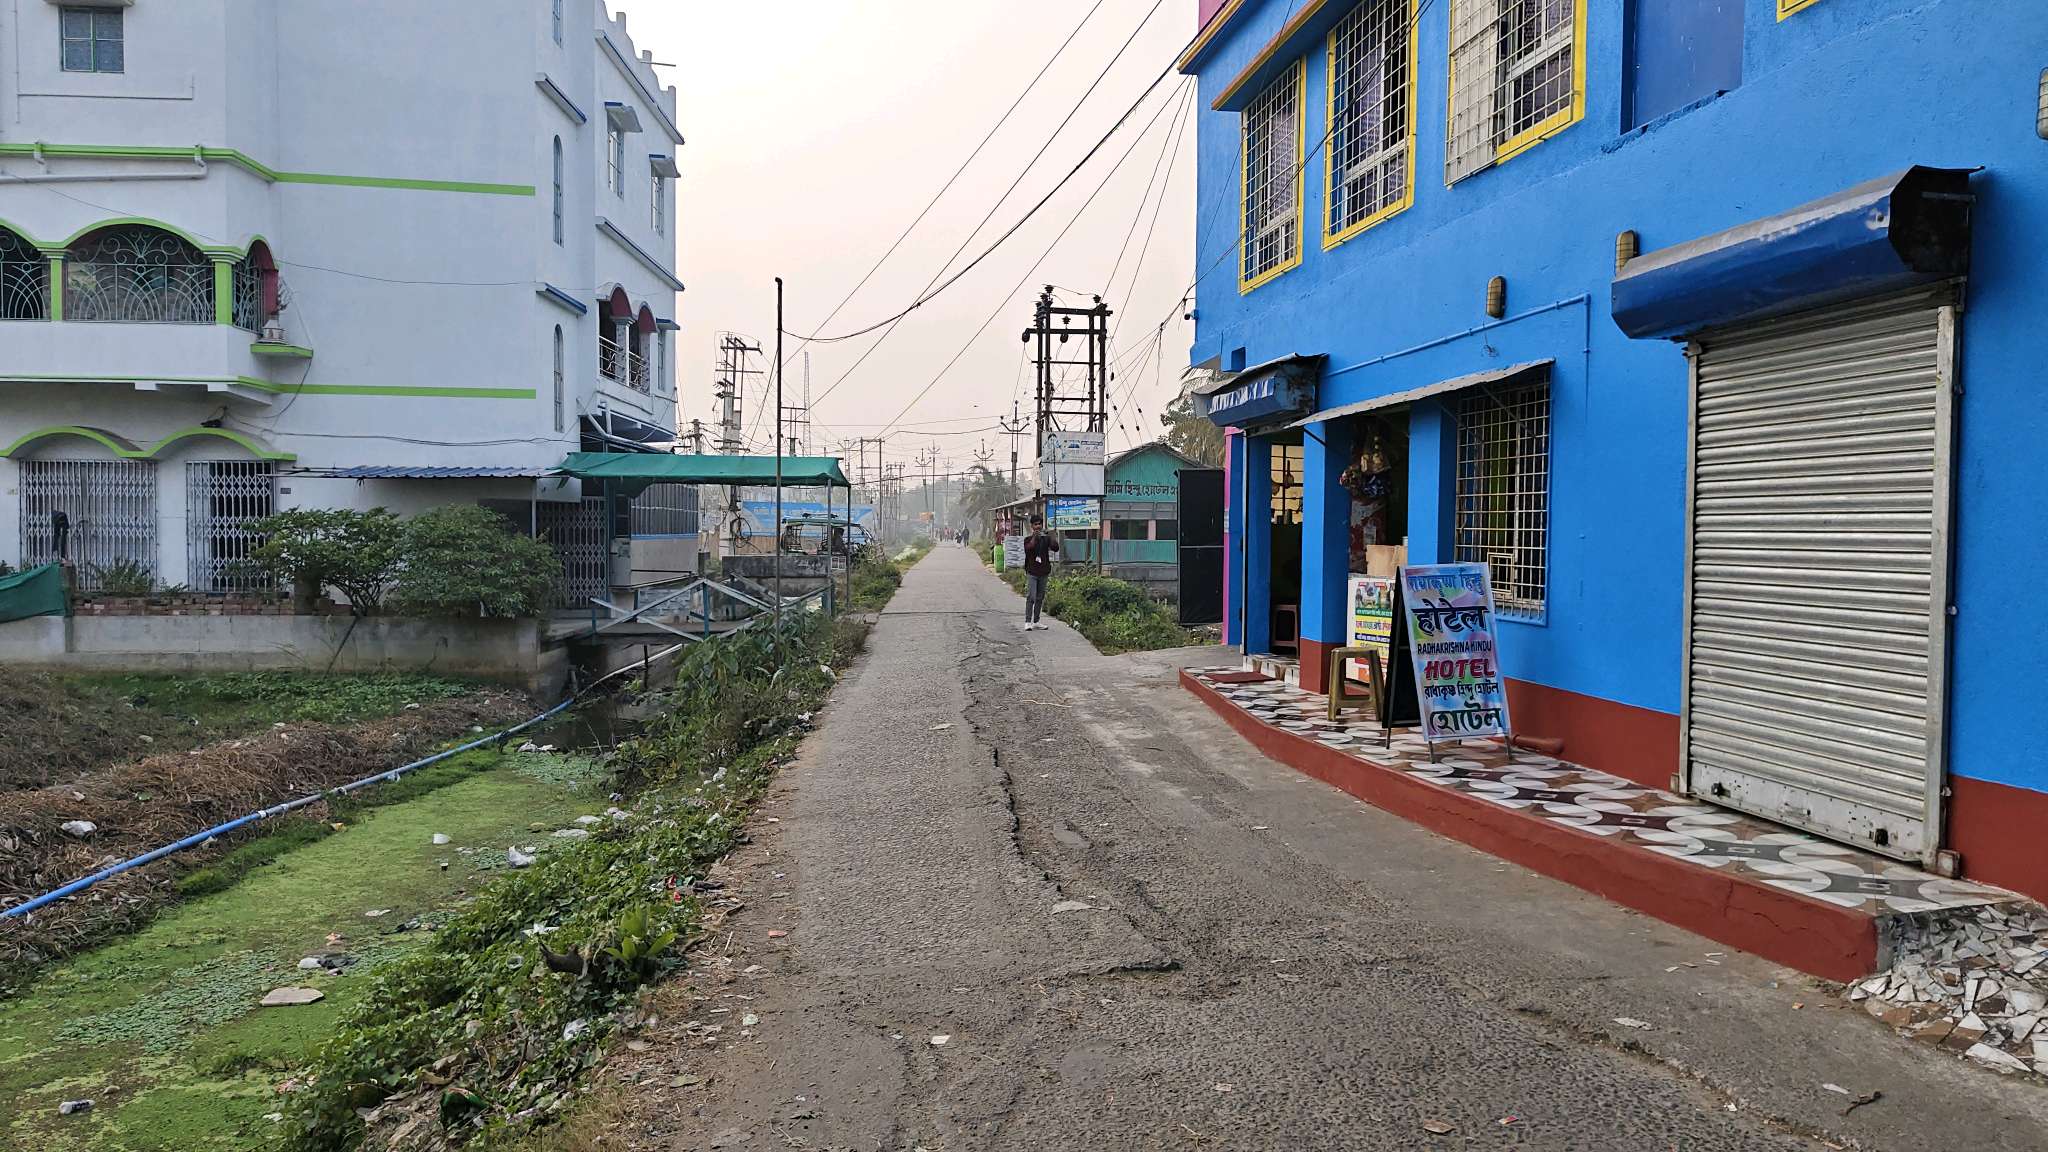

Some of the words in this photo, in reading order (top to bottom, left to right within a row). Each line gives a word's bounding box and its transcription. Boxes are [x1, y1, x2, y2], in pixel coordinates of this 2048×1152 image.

[1411, 598, 1489, 636] होटेल
[1417, 640, 1470, 655] RADHAKRISHNA
[1470, 639, 1492, 652] HINDU
[1424, 658, 1496, 681] HOTEL
[1430, 701, 1502, 734] হোটেল
